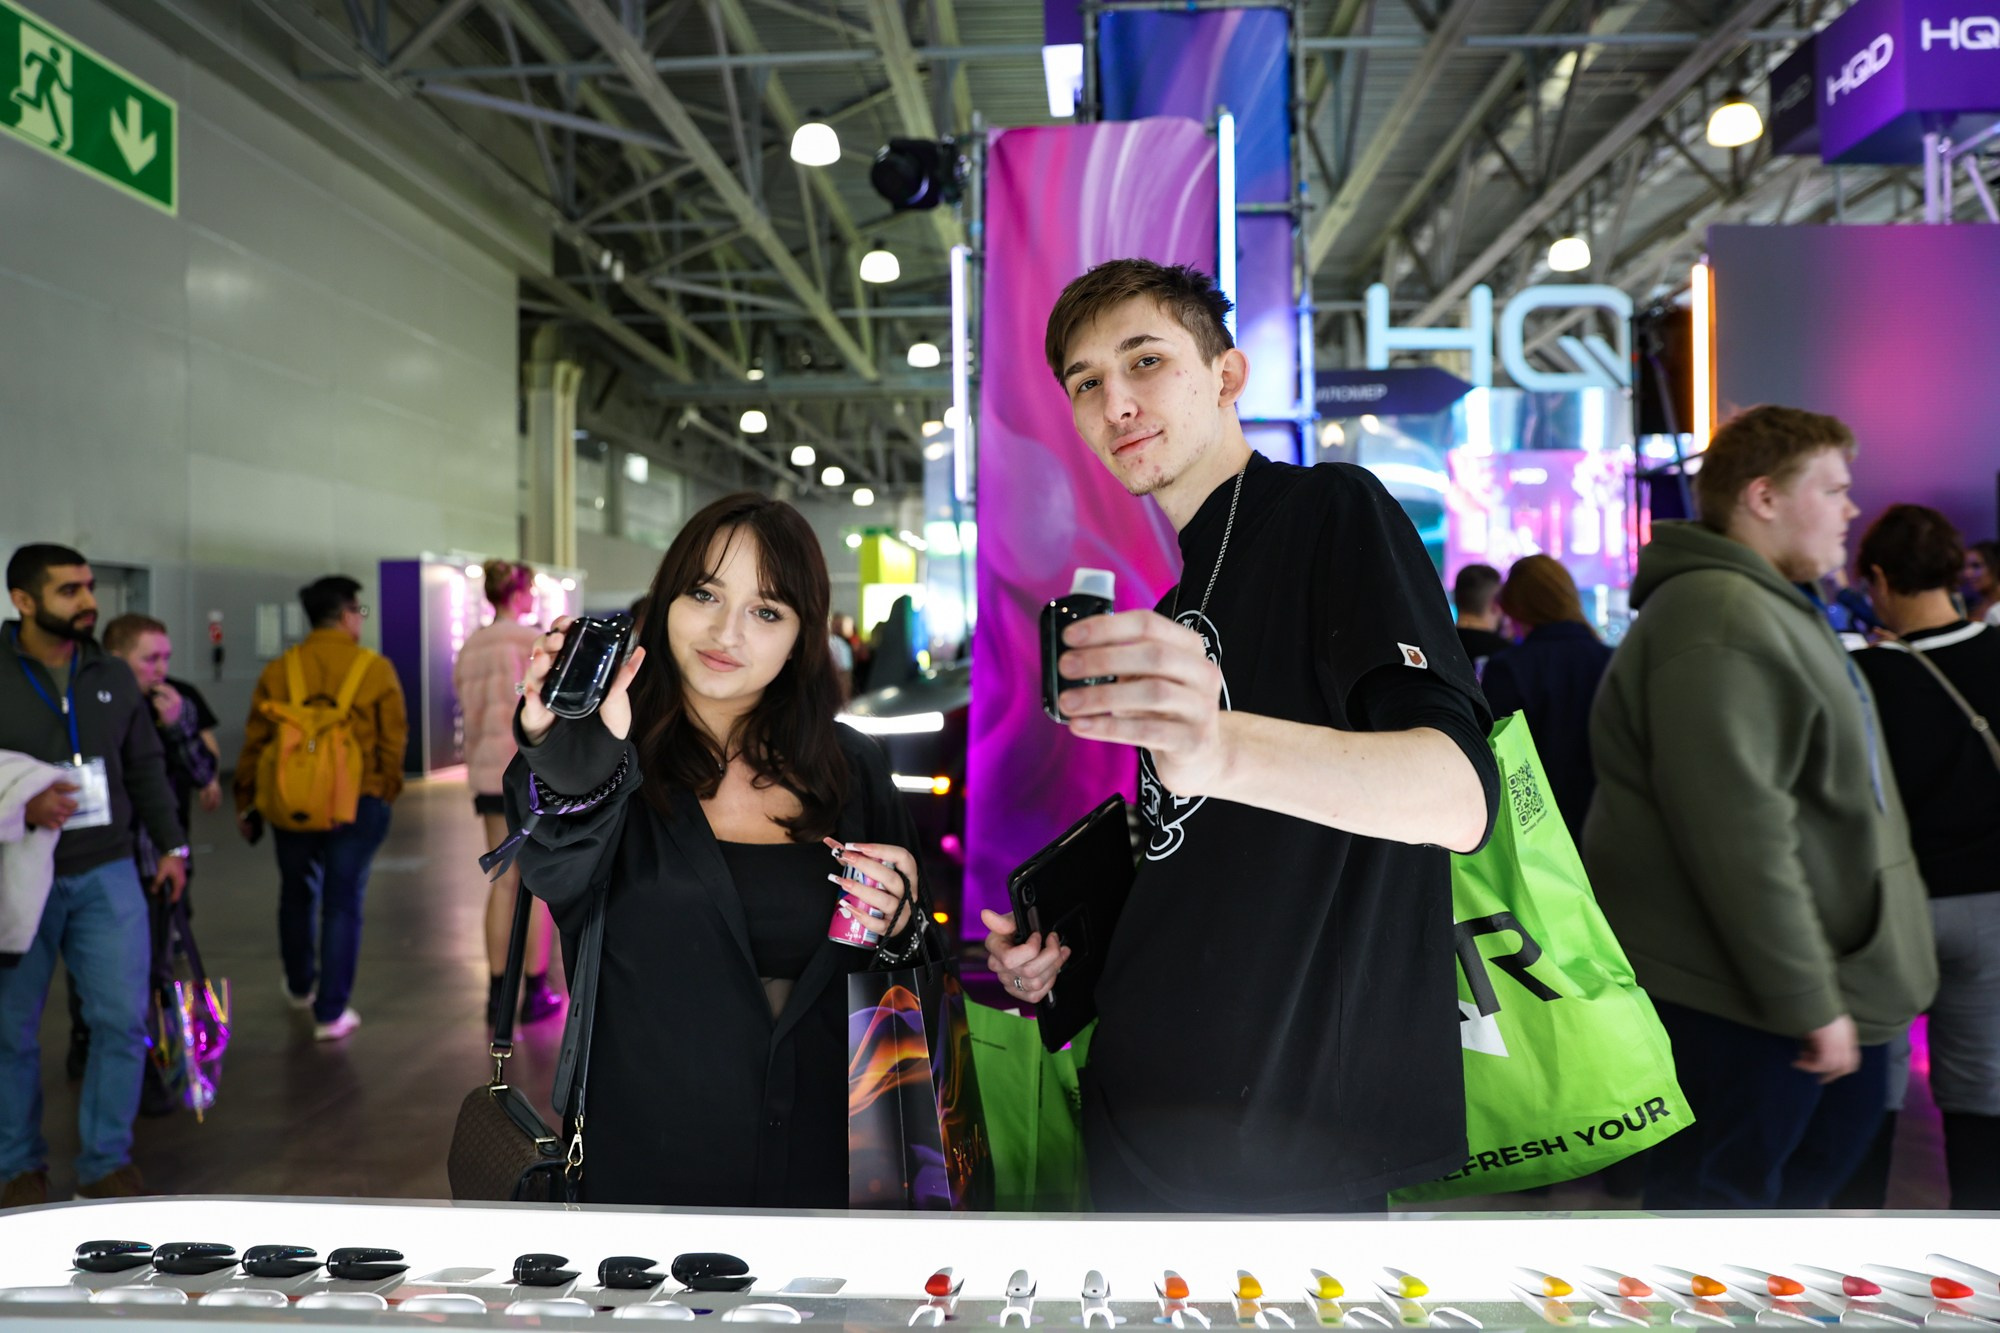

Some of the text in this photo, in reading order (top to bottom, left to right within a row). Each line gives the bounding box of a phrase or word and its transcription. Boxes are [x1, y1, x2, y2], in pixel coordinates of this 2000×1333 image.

[1826, 33, 1894, 106] HQD
[1434, 1096, 1670, 1182] FRESH YOUR
